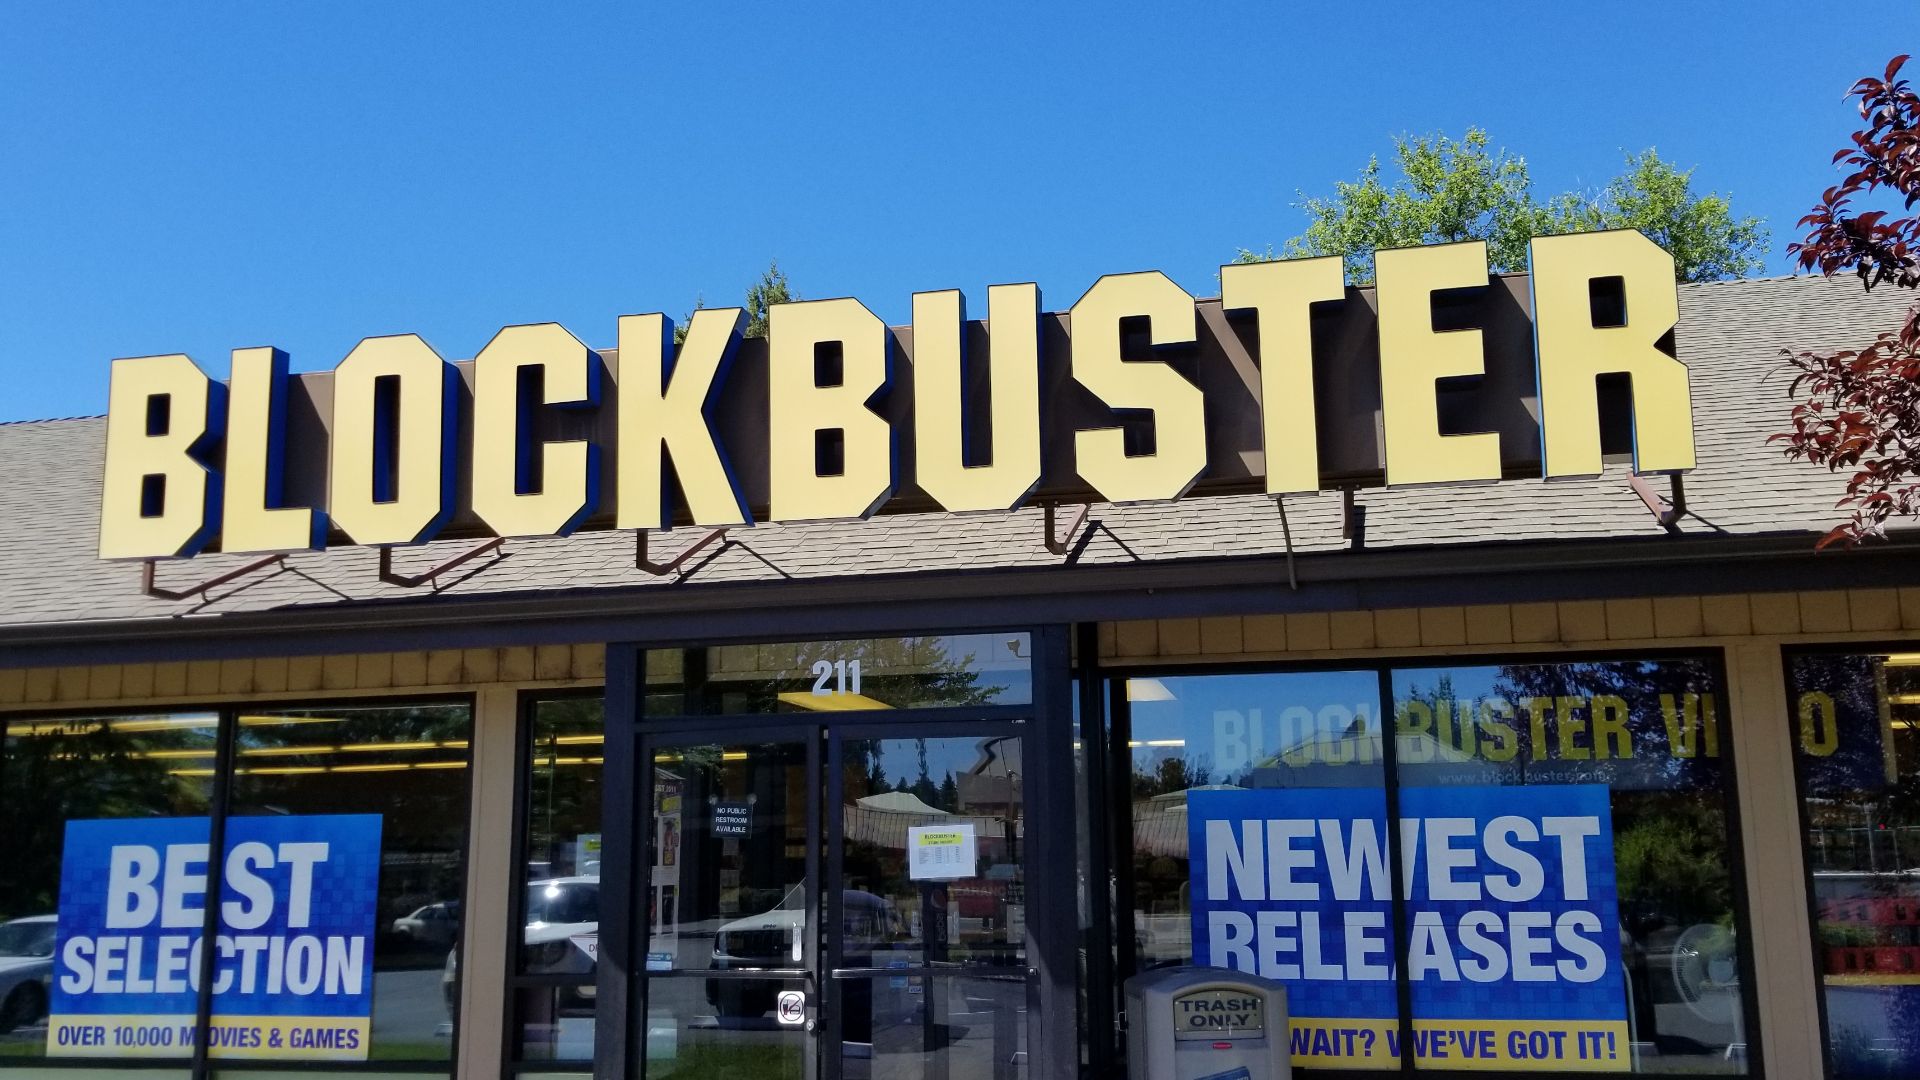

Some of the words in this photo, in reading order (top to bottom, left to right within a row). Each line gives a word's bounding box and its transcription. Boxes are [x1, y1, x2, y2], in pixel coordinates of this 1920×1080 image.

[98, 228, 1697, 561] BLOCKBUSTER
[812, 659, 860, 697] 211
[715, 816, 748, 824] RESTROOM
[727, 807, 747, 815] PUBLIC
[715, 825, 747, 833] AVAILABLE
[1205, 815, 1600, 902] NEWEST
[106, 842, 329, 930] BEST
[1208, 910, 1607, 982] RELEASES
[60, 936, 365, 995] SELECTION
[1180, 999, 1257, 1012] TRASH
[1189, 1013, 1250, 1027] ONLY
[57, 1025, 106, 1047] OVER
[113, 1026, 172, 1048] 10,000
[179, 1026, 261, 1048] MOVIES
[267, 1028, 283, 1048] &
[289, 1028, 360, 1049] GAMES
[1386, 1029, 1497, 1059] WE'VE
[1507, 1030, 1567, 1060] GOT
[1577, 1031, 1617, 1060] IT!
